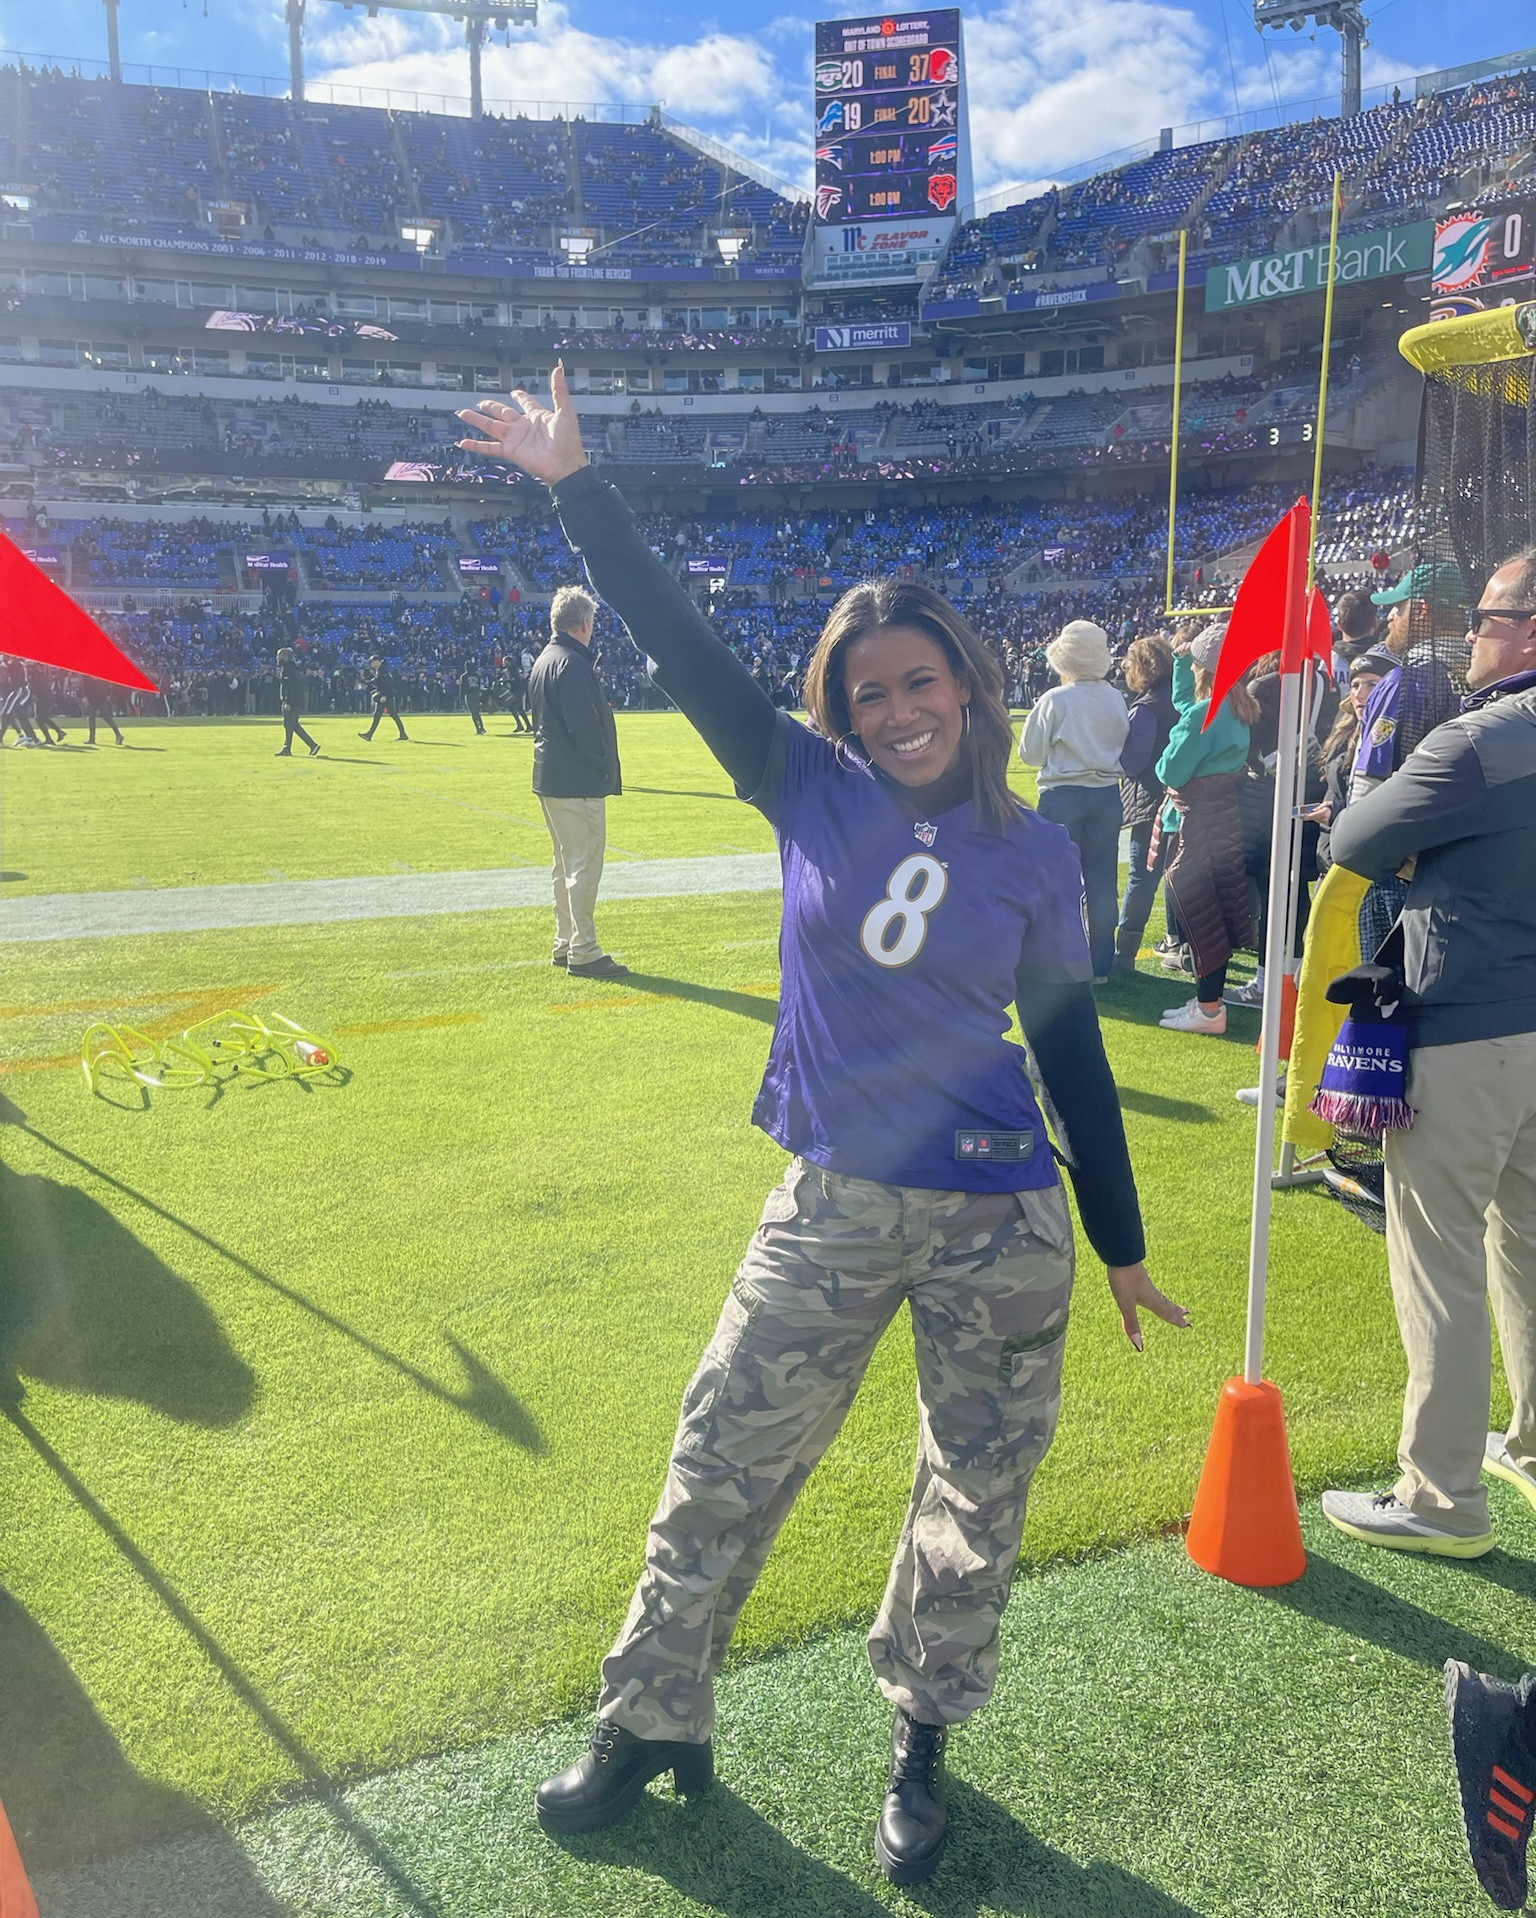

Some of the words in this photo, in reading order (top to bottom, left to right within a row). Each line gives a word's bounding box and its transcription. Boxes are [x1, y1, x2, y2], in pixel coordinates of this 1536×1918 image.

[842, 25, 881, 37] MARYLAND
[858, 39, 866, 51] OF
[886, 33, 929, 48] SCOREBOARD
[842, 60, 863, 88] 20
[875, 66, 897, 80] FINAL
[909, 54, 929, 82] 37
[843, 102, 861, 130] 19
[874, 108, 897, 122] FINAL
[908, 97, 929, 124] 20
[888, 149, 901, 163] PM
[870, 192, 886, 206] 1:00
[873, 230, 929, 242] FLAVOR
[1503, 213, 1522, 258] 0
[98, 235, 117, 245] AFC
[118, 236, 151, 247] NORTH
[153, 239, 209, 251] CHAMPIONS
[212, 243, 234, 254] 2003
[243, 246, 266, 256] 2006
[274, 248, 295, 259] 2011
[304, 251, 327, 262] 2012
[334, 253, 357, 264] 2018
[364, 256, 387, 266] 2019
[869, 240, 908, 251] ZONE
[534, 267, 556, 278] THANK
[557, 267, 569, 278] YOU
[570, 267, 604, 279] FRONTLINE
[1224, 248, 1314, 304] M&T
[1316, 231, 1407, 285] Bank
[1035, 289, 1088, 307] #RAVENSFLOCK
[853, 326, 898, 341] merritt
[860, 853, 949, 968] 8
[1327, 1052, 1403, 1074] RAVENS
